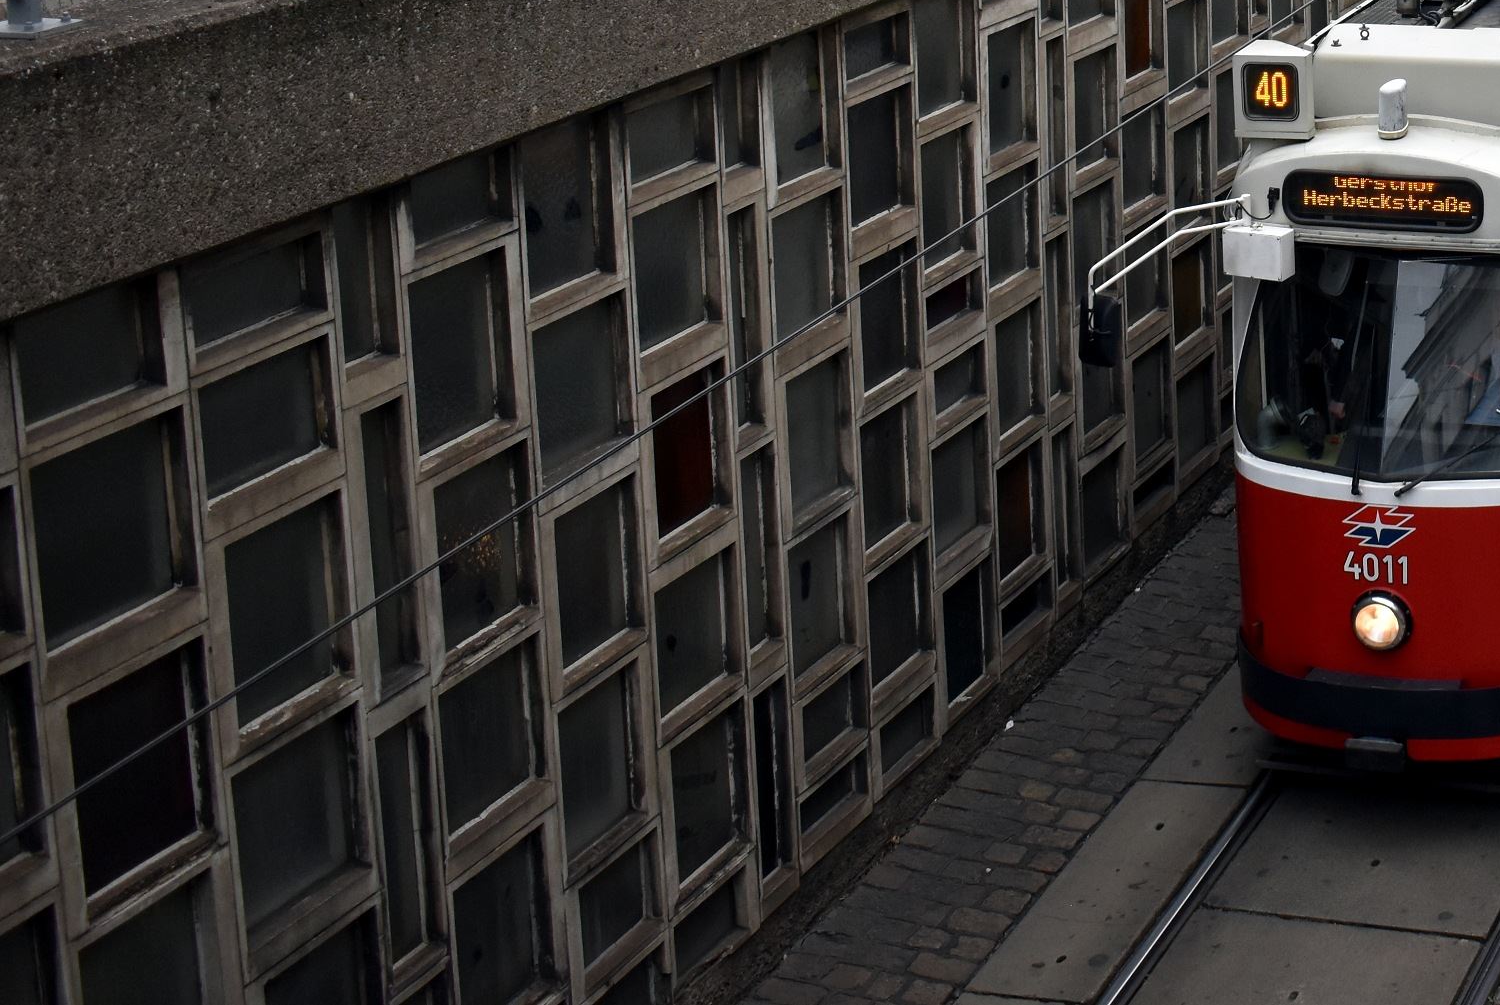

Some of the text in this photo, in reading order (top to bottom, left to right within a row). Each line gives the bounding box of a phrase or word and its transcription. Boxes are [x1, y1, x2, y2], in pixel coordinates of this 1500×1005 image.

[1256, 71, 1287, 107] 40
[1303, 189, 1472, 214] Herbeckstraße
[1343, 550, 1408, 585] 4011
